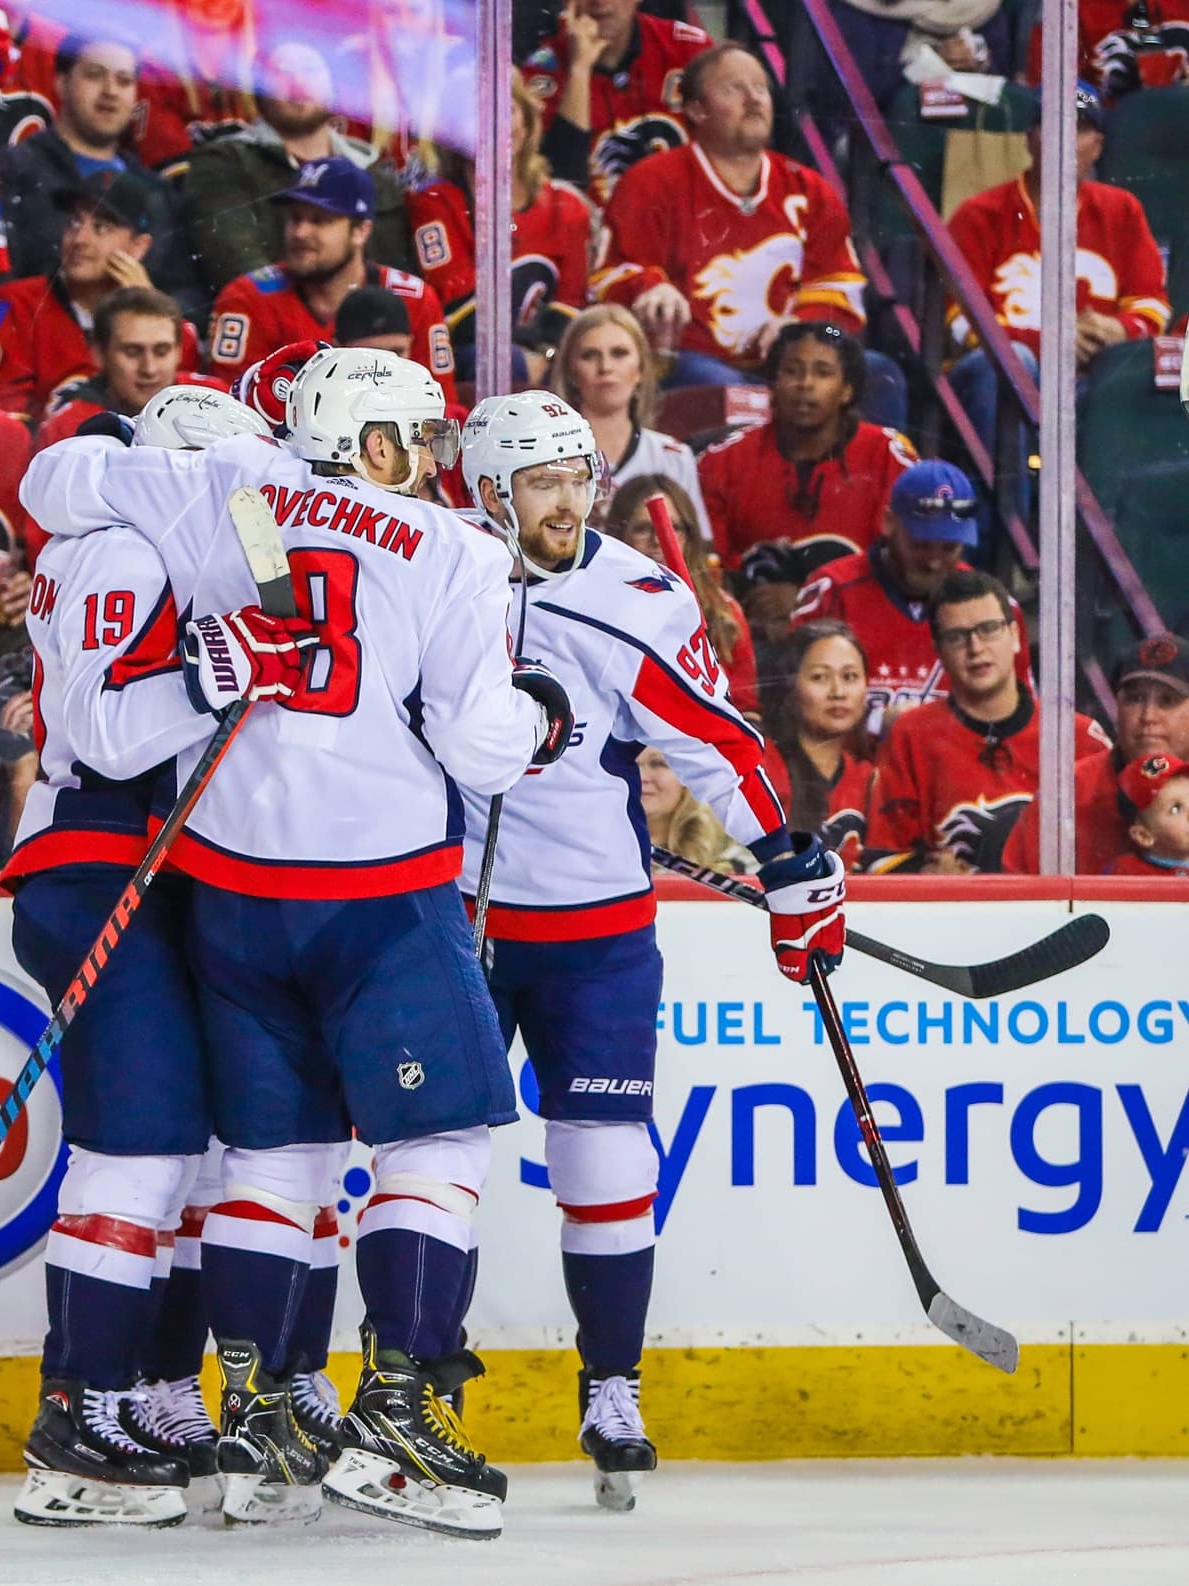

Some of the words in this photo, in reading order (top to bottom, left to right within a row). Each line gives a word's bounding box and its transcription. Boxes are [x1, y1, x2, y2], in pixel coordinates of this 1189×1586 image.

[415, 221, 452, 270] 8
[541, 403, 569, 418] 92
[259, 484, 424, 562] OVECHKIN
[82, 590, 136, 650] 19
[276, 546, 363, 718] 8
[676, 624, 720, 697] 92
[568, 1077, 653, 1098] BAUER
[223, 1351, 250, 1359] CCM
[415, 1437, 454, 1464] CCM
